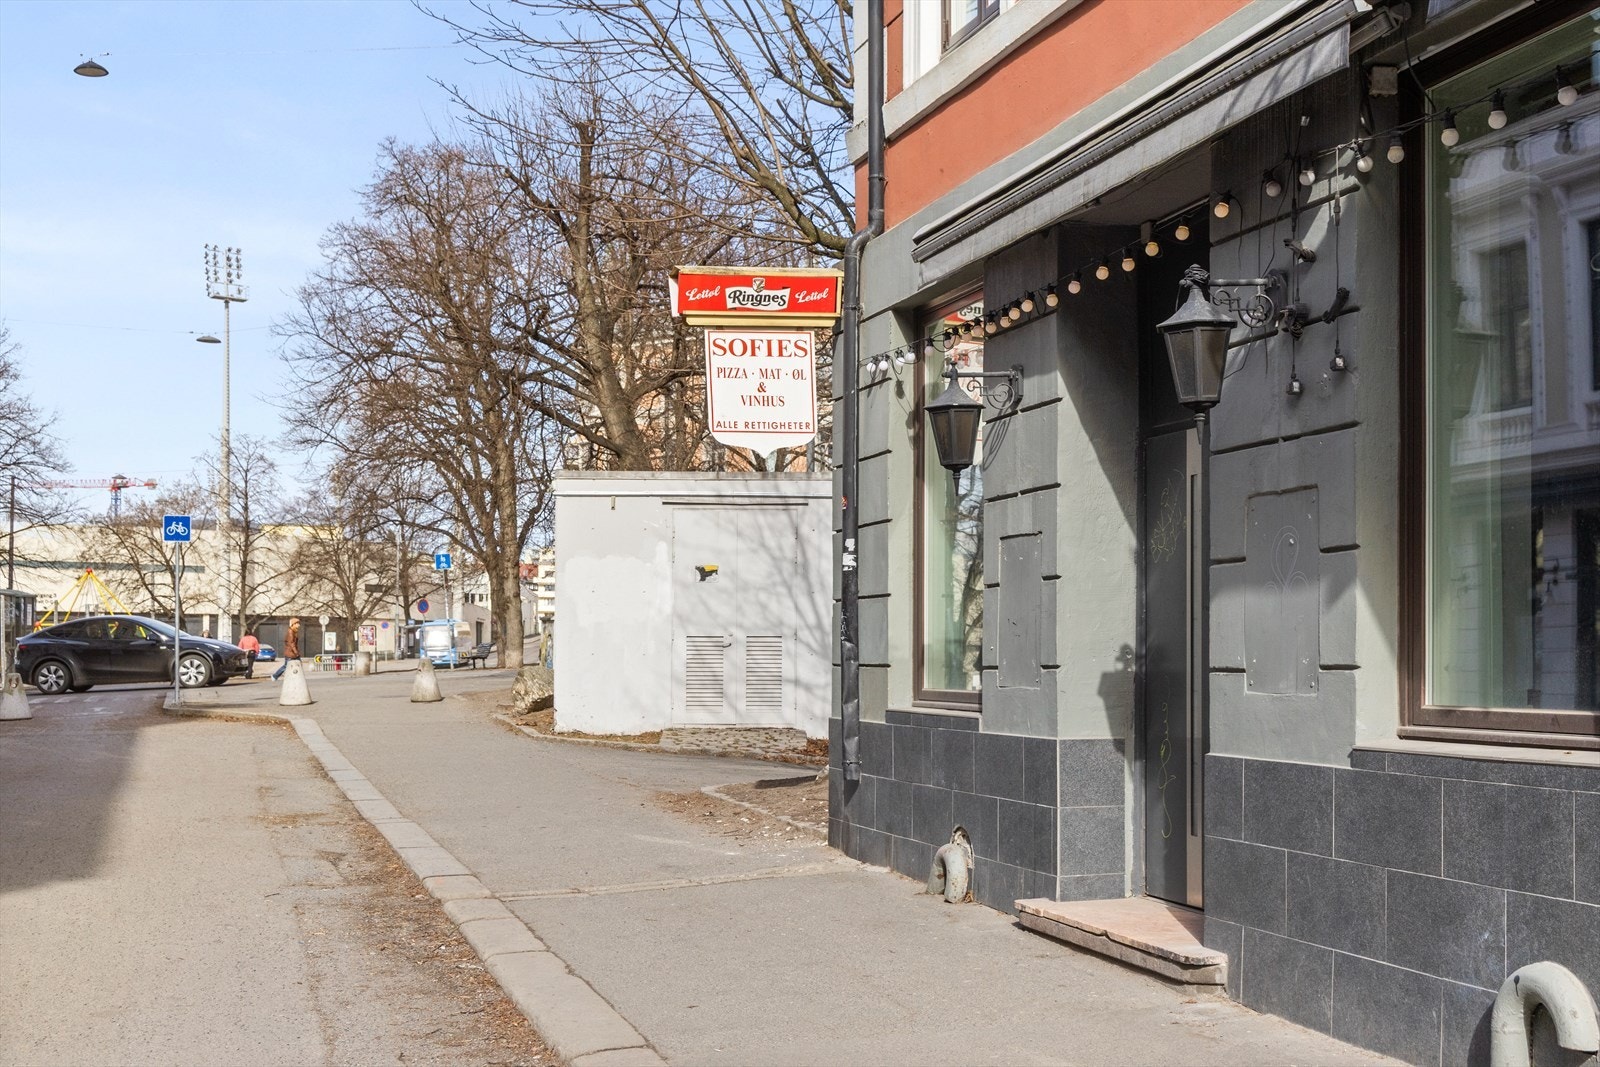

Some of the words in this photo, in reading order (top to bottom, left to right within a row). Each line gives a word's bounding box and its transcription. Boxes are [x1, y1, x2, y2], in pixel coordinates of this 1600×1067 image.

[728, 290, 787, 307] Ringnes
[712, 338, 808, 358] SOFIES
[717, 367, 748, 379] PIZZA
[759, 368, 782, 379] MAT
[792, 368, 807, 380] ØL
[757, 382, 767, 393] &
[741, 395, 785, 407] VINHUS
[716, 421, 738, 429] ALLE
[744, 421, 811, 430] RETTIGHETER
